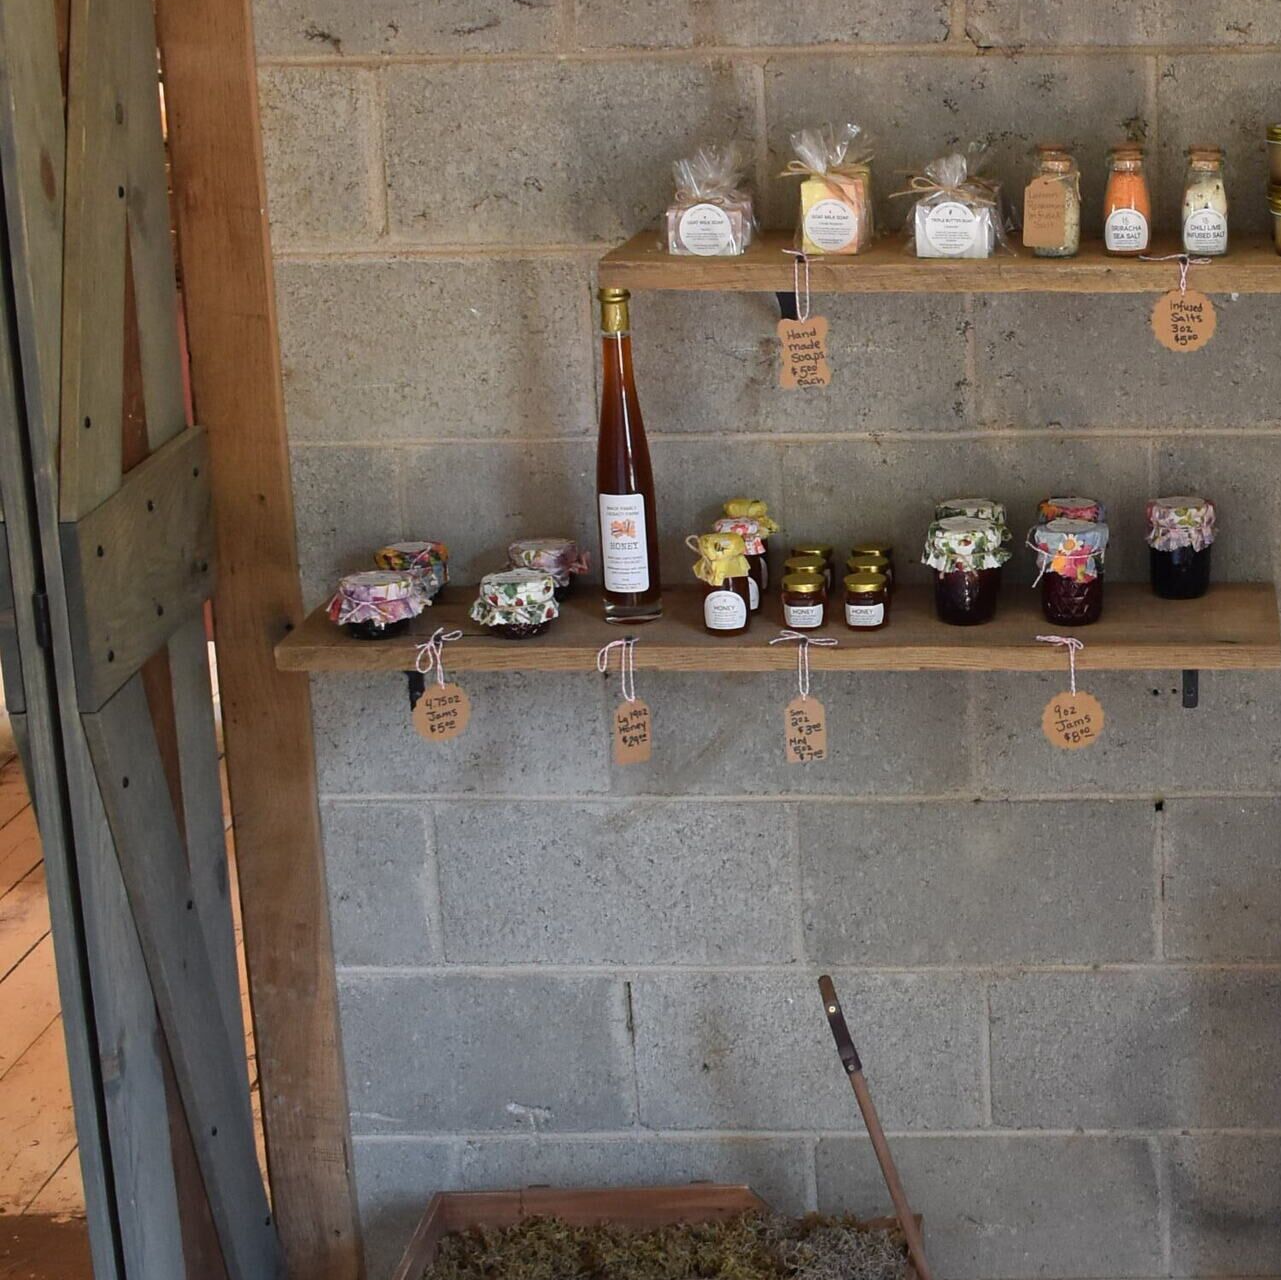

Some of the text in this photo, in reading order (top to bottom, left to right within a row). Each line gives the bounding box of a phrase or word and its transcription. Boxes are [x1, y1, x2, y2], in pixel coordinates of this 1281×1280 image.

[1207, 223, 1222, 231] LIME
[1113, 232, 1142, 240] SEA SALT
[1170, 300, 1203, 313] Infused
[1171, 312, 1203, 324] Salts
[786, 327, 817, 340] Hand
[788, 339, 821, 351] made
[797, 377, 826, 387] each
[609, 541, 639, 551] HONEY
[426, 709, 458, 722] Jams
[618, 720, 647, 735] Honey
[1055, 714, 1092, 733] Jams
